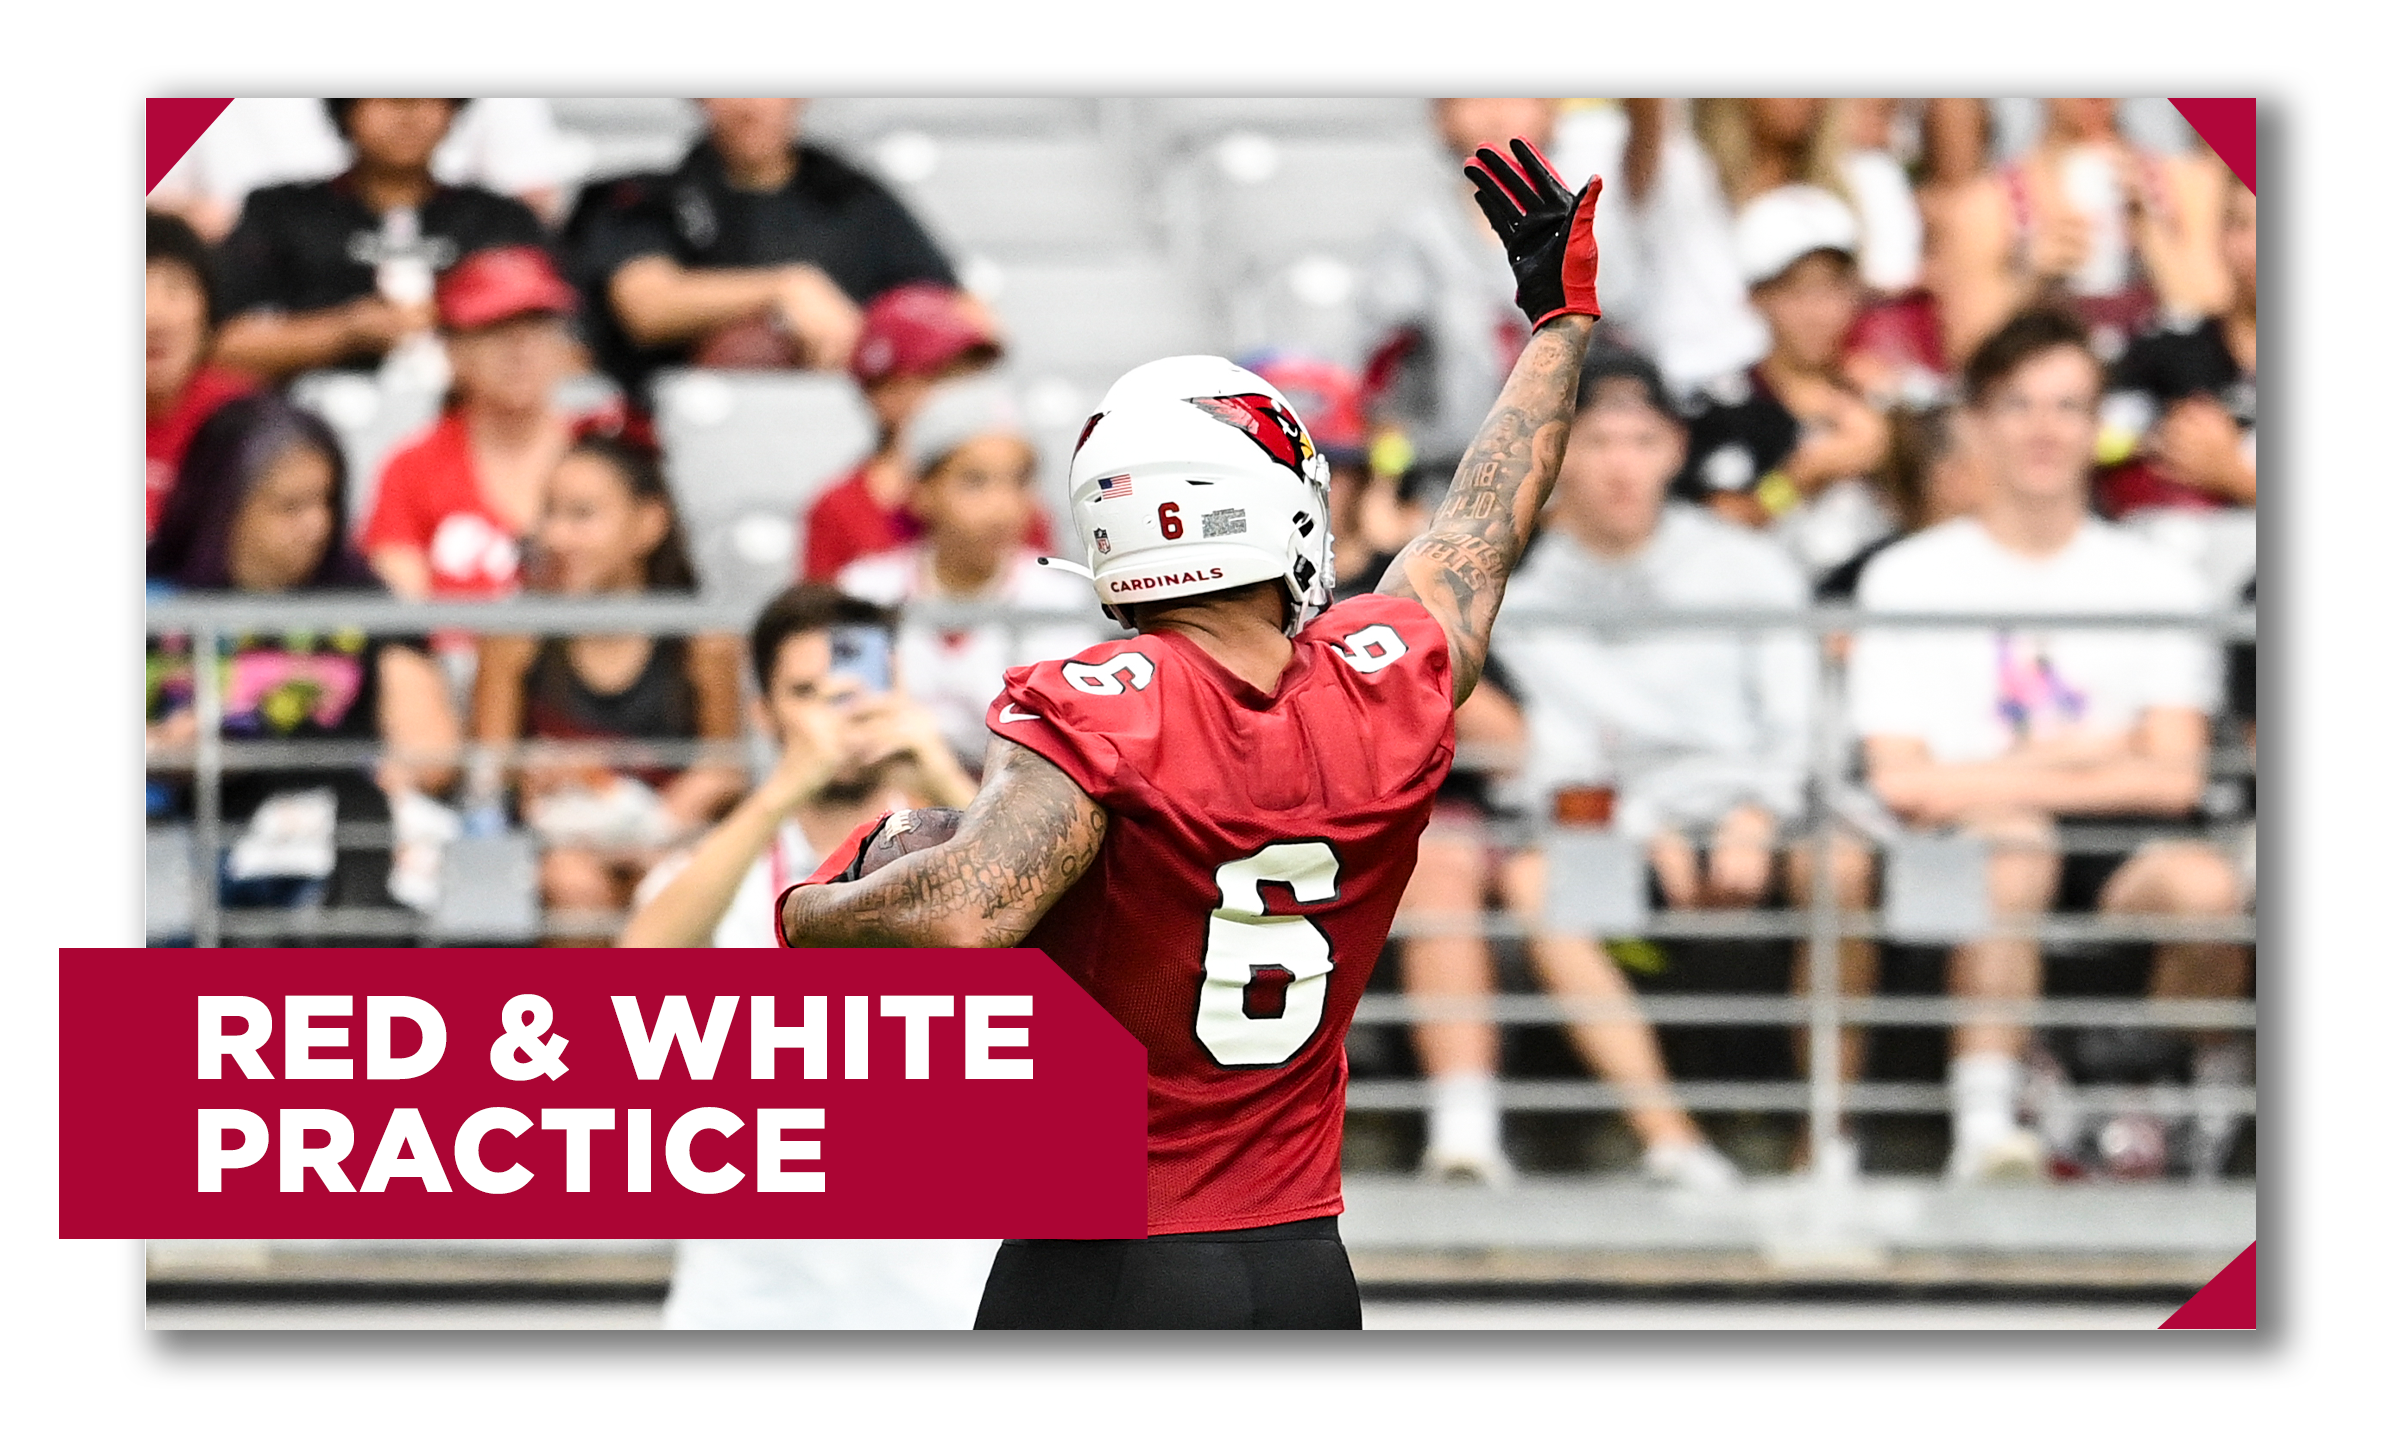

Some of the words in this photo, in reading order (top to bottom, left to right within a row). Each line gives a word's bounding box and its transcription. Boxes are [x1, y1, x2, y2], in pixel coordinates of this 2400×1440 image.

[1157, 501, 1184, 541] 6
[1110, 567, 1224, 594] CARDINALS
[1331, 623, 1409, 675] 6
[1060, 650, 1156, 697] 6
[1193, 836, 1343, 1071] 6
